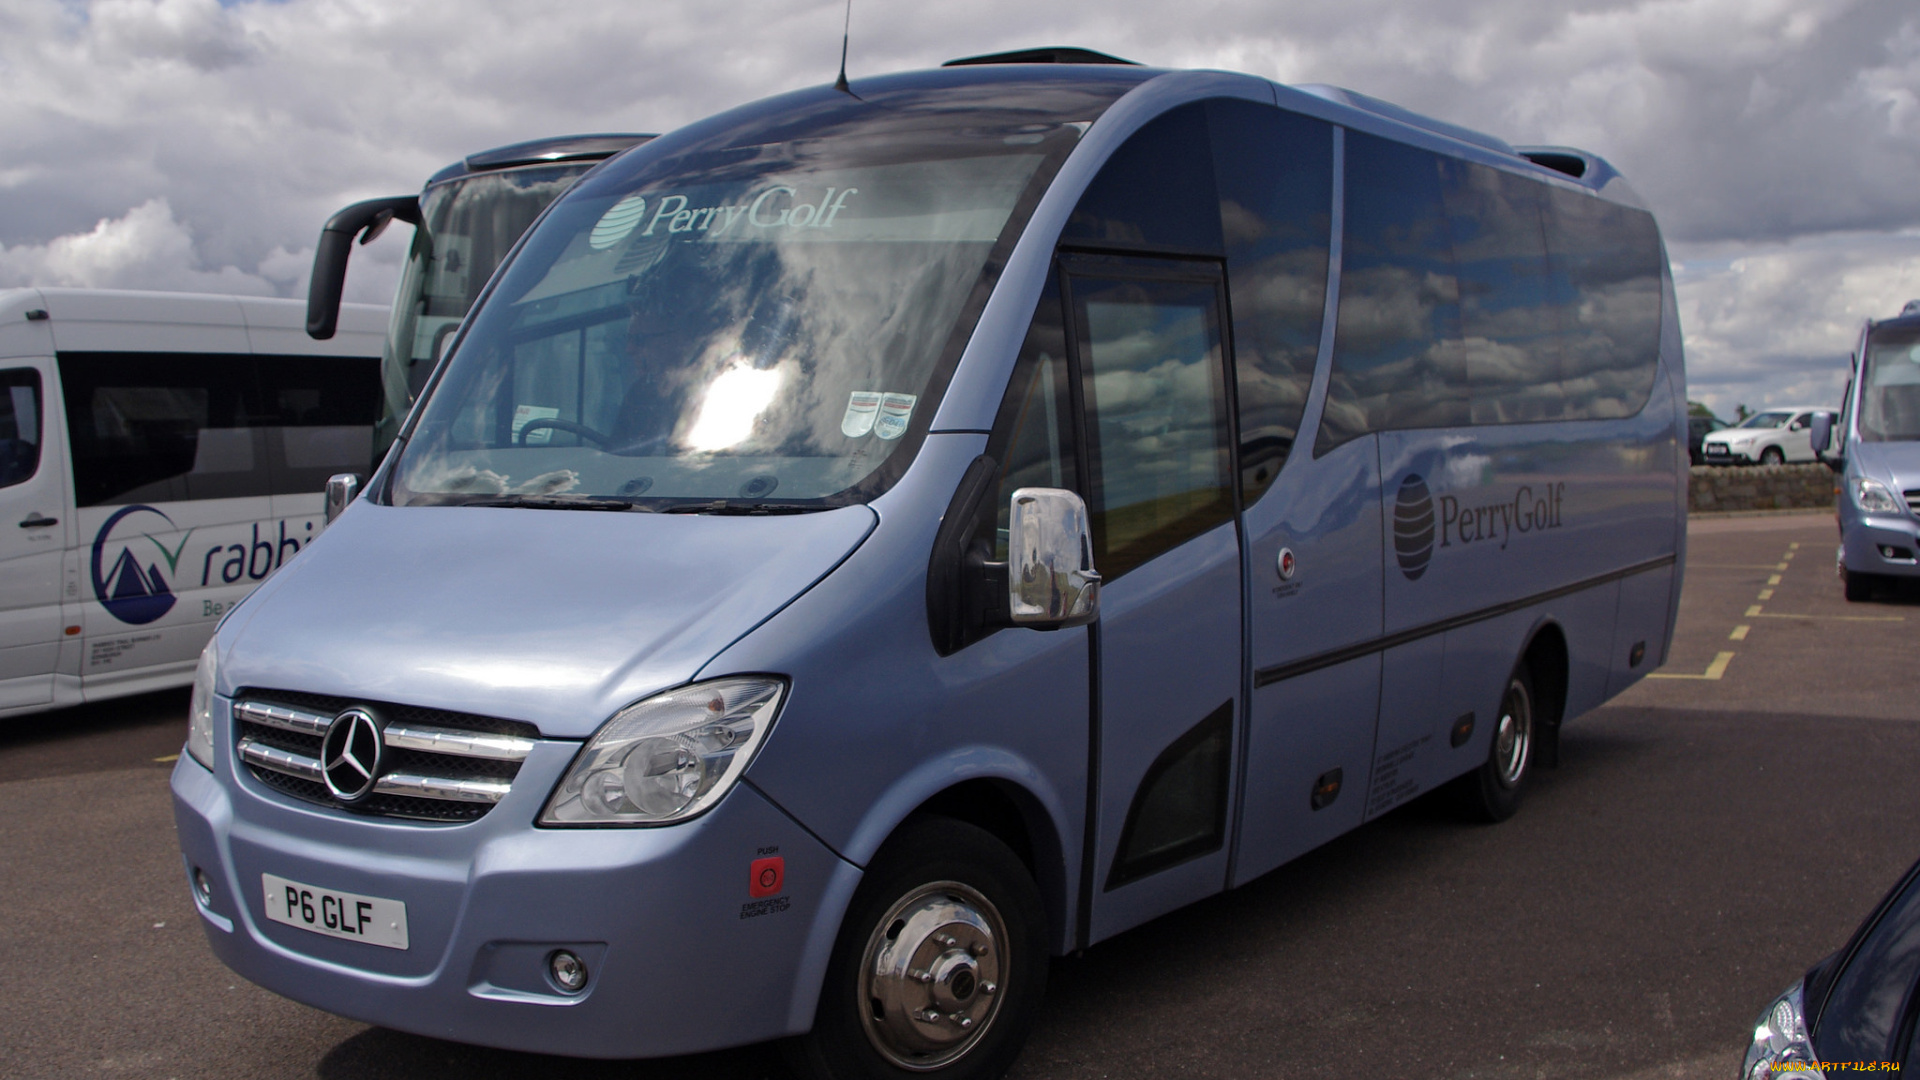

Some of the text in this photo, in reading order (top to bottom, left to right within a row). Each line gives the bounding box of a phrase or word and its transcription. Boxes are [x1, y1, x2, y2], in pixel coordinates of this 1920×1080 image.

[642, 185, 858, 238] PerryGolf
[1440, 481, 1565, 551] PerryGolf
[202, 599, 223, 617] Be
[757, 846, 779, 855] PUSH
[285, 886, 372, 935] P6 GLF
[740, 903, 791, 919] ENGINE STOP
[742, 896, 790, 911] EMERGENCY
